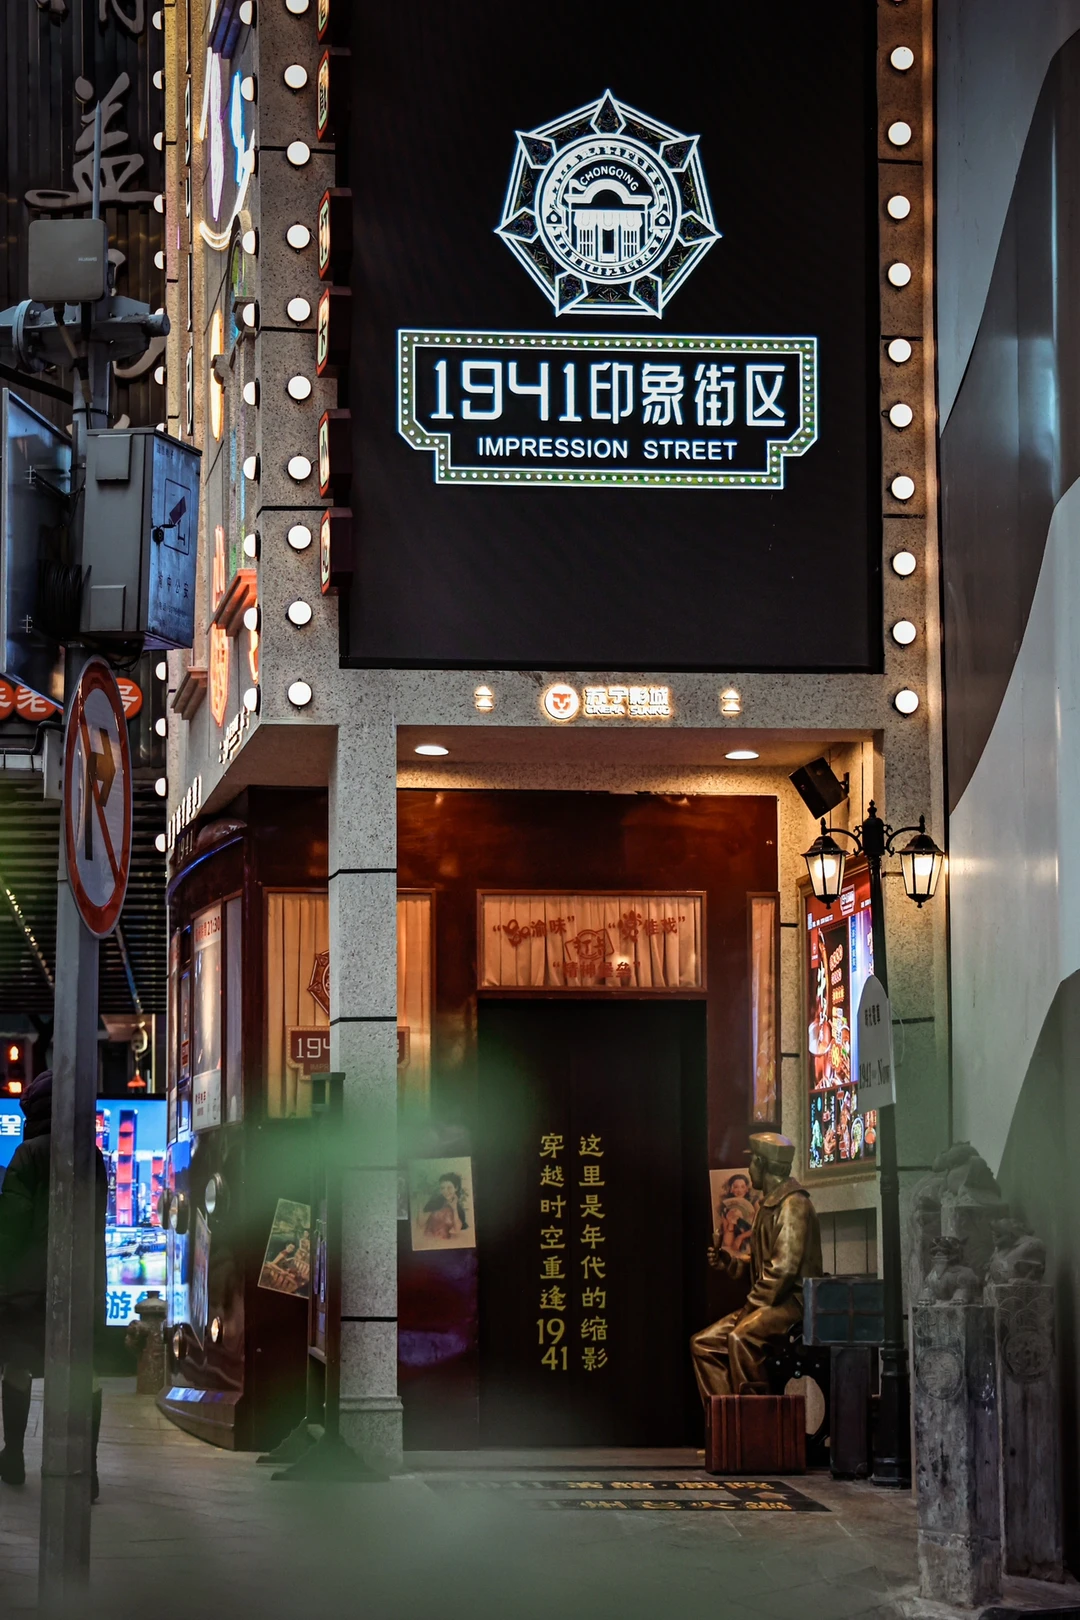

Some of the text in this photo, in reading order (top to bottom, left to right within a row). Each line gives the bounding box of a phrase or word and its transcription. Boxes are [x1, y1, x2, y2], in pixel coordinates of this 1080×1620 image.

[580, 166, 639, 191] CHONGQING
[431, 359, 785, 427] 1941印象街区
[478, 437, 737, 461] IMPRESSION STREET
[578, 1133, 608, 1371] 这里是年代的缩影
